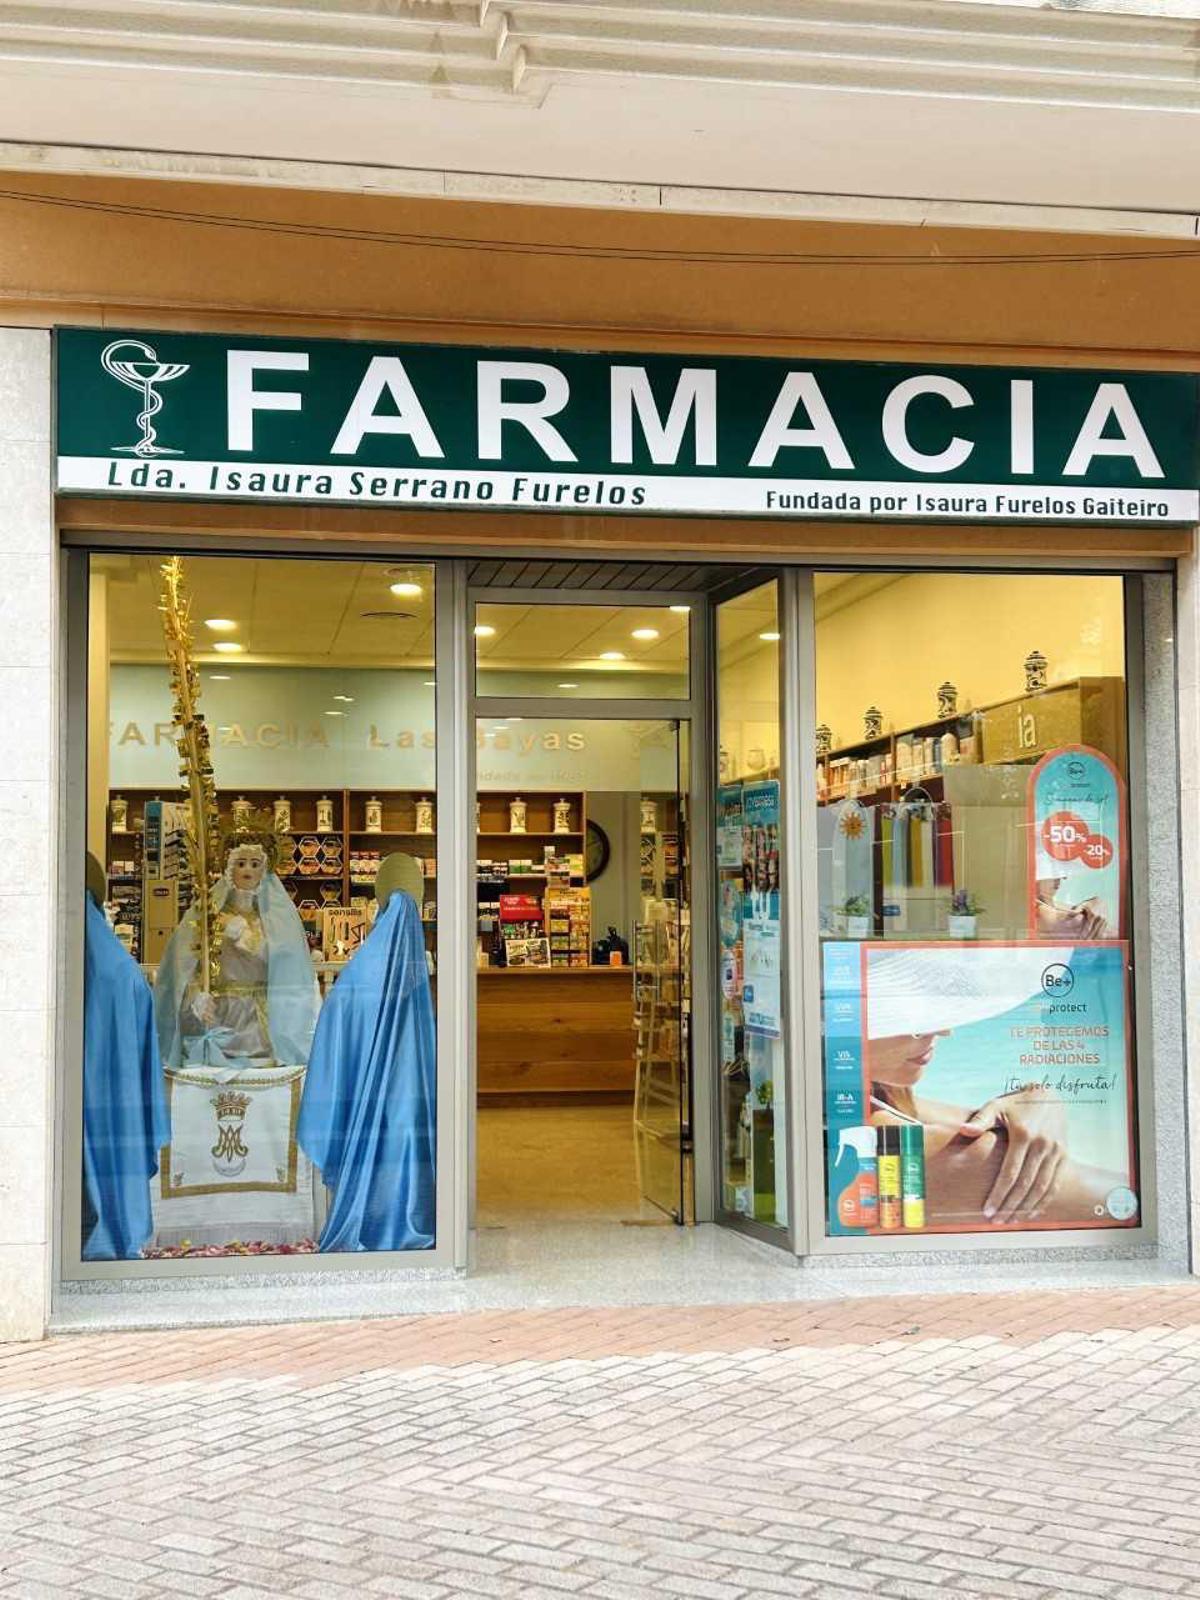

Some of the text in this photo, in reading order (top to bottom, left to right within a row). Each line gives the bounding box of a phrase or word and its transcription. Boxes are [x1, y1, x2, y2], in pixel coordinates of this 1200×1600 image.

[228, 350, 1164, 478] FARMACIA
[108, 462, 646, 505] Lda. Isaura Serrano Furelos
[766, 492, 1169, 517] Fundada por Isaura Furelos Gaiteiro
[1045, 974, 1071, 987] Be+
[1033, 1040, 1050, 1051] DE
[1052, 1040, 1074, 1051] LAS
[1019, 1053, 1101, 1065] RADIACIONES
